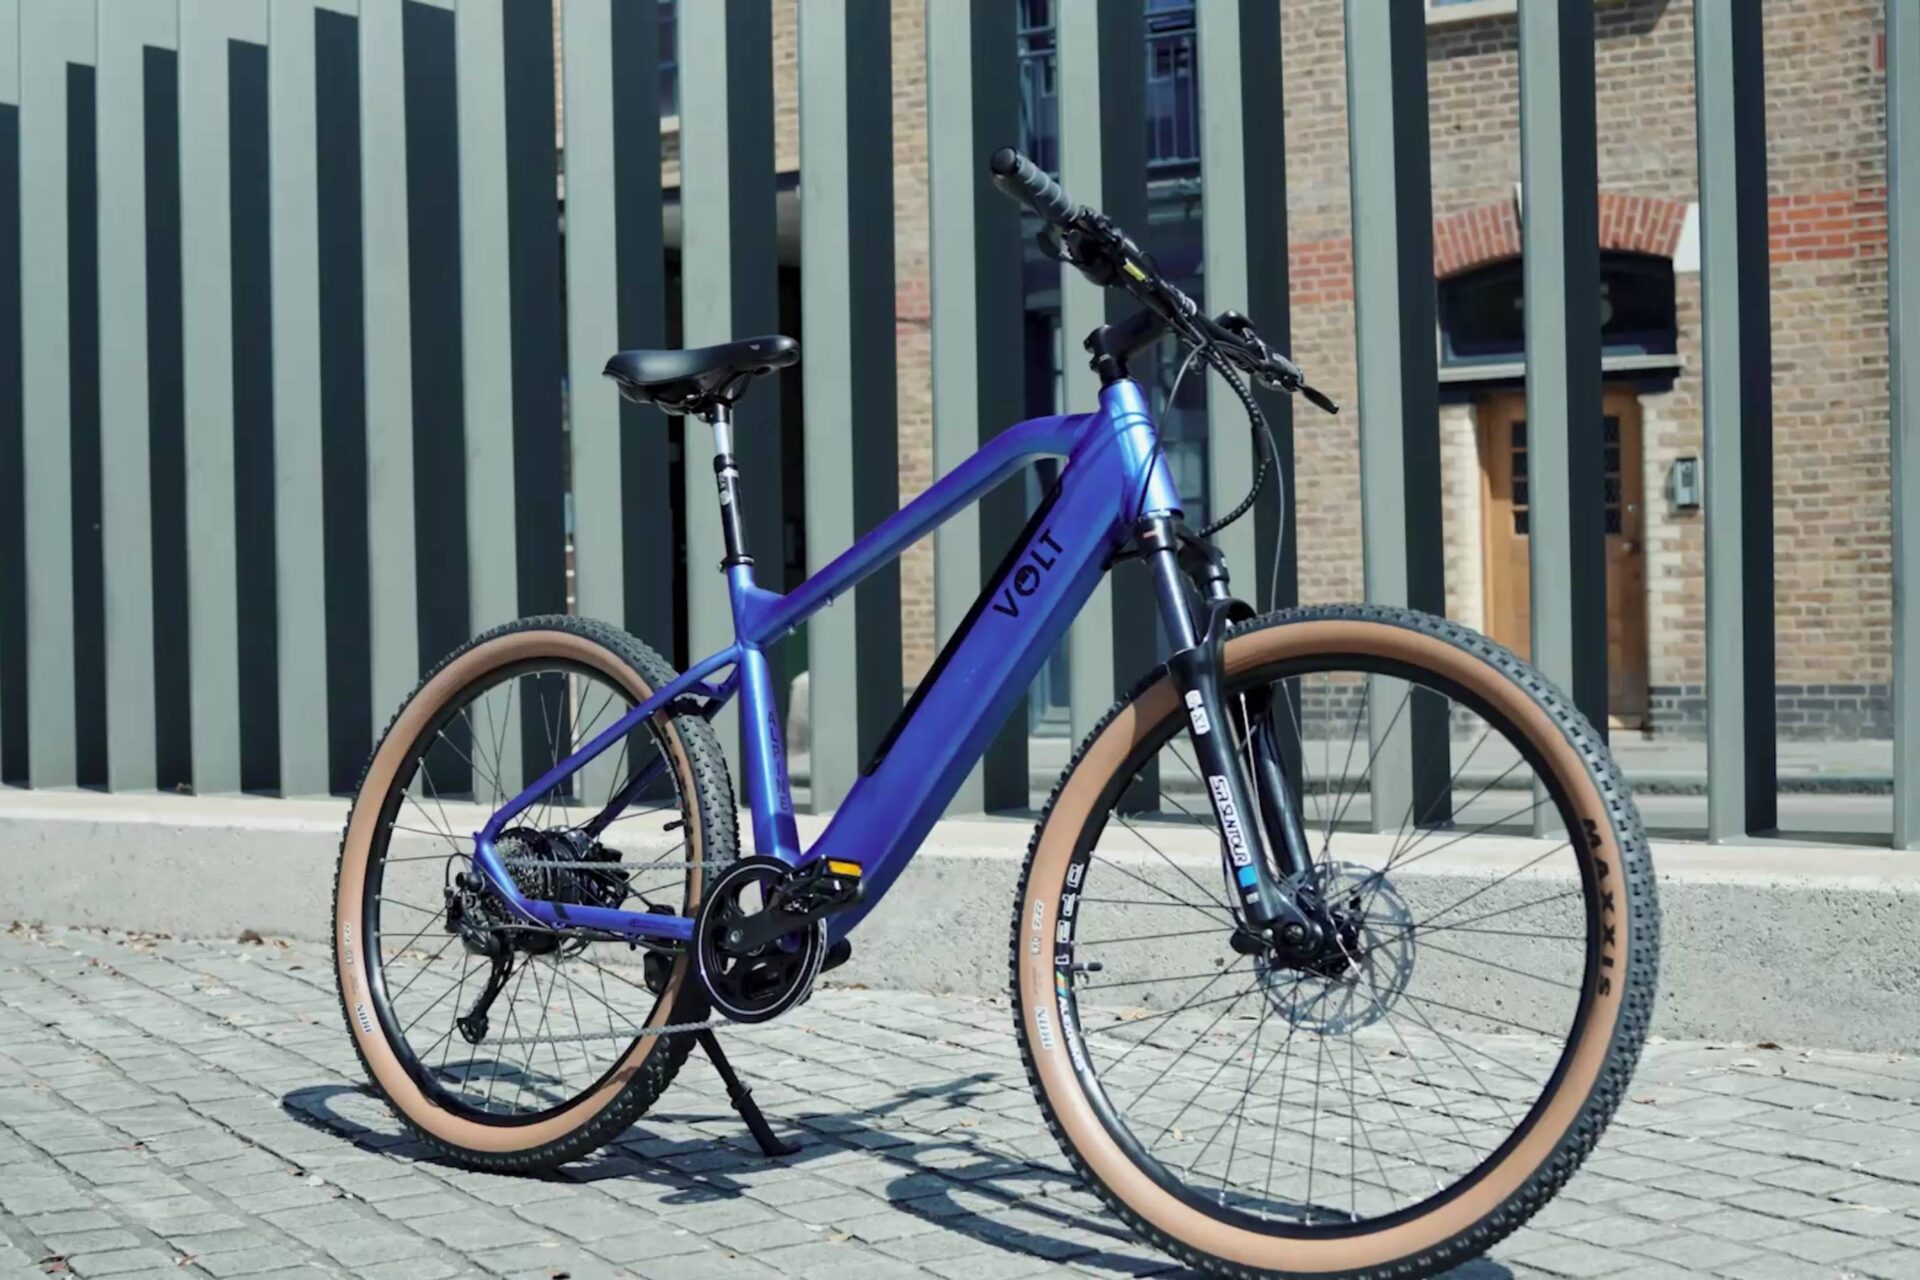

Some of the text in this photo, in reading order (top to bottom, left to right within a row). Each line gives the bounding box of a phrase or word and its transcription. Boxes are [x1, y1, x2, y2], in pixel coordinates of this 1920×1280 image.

[992, 528, 1063, 618] VOLT
[768, 710, 789, 811] ALPINE
[1220, 804, 1250, 864] SUNTOUR
[1582, 818, 1616, 997] MAXXIS
